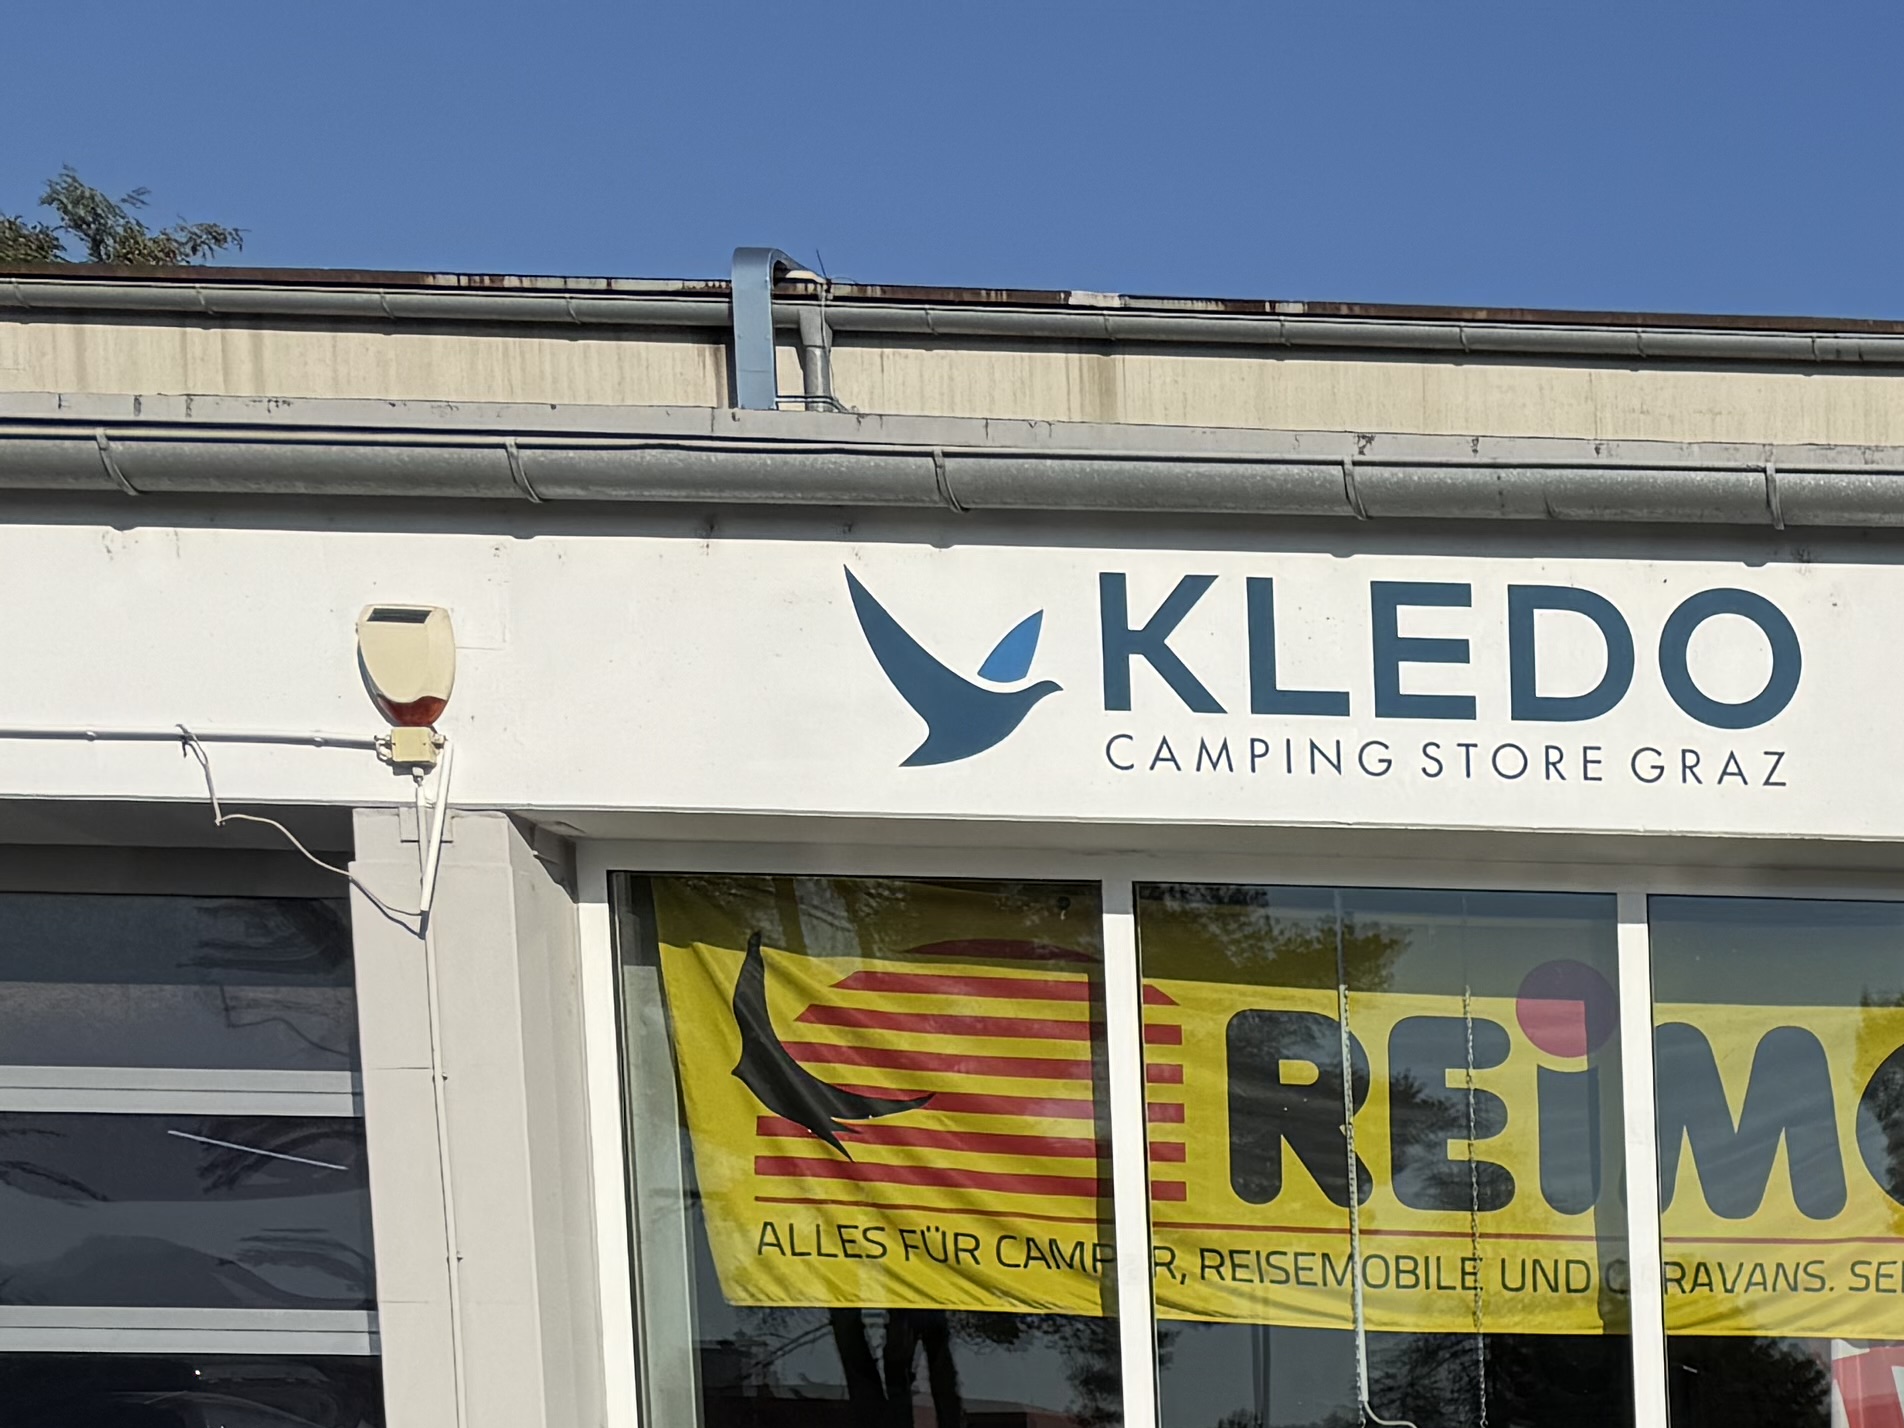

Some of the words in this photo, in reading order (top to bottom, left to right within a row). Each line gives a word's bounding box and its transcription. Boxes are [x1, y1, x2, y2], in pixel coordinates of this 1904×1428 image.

[1099, 572, 1803, 731] KLEDO
[1104, 733, 1394, 780] CAMPING
[1420, 741, 1604, 783] STORE
[1630, 747, 1788, 789] GRAZ
[757, 1220, 888, 1259] ALLES
[898, 1225, 981, 1267] FÜR
[995, 1233, 1188, 1287] CAMPR,
[1199, 1246, 1484, 1294] REISEMOBILE
[1500, 1254, 1592, 1294] UND
[1603, 1257, 1836, 1295] CRAVANS.
